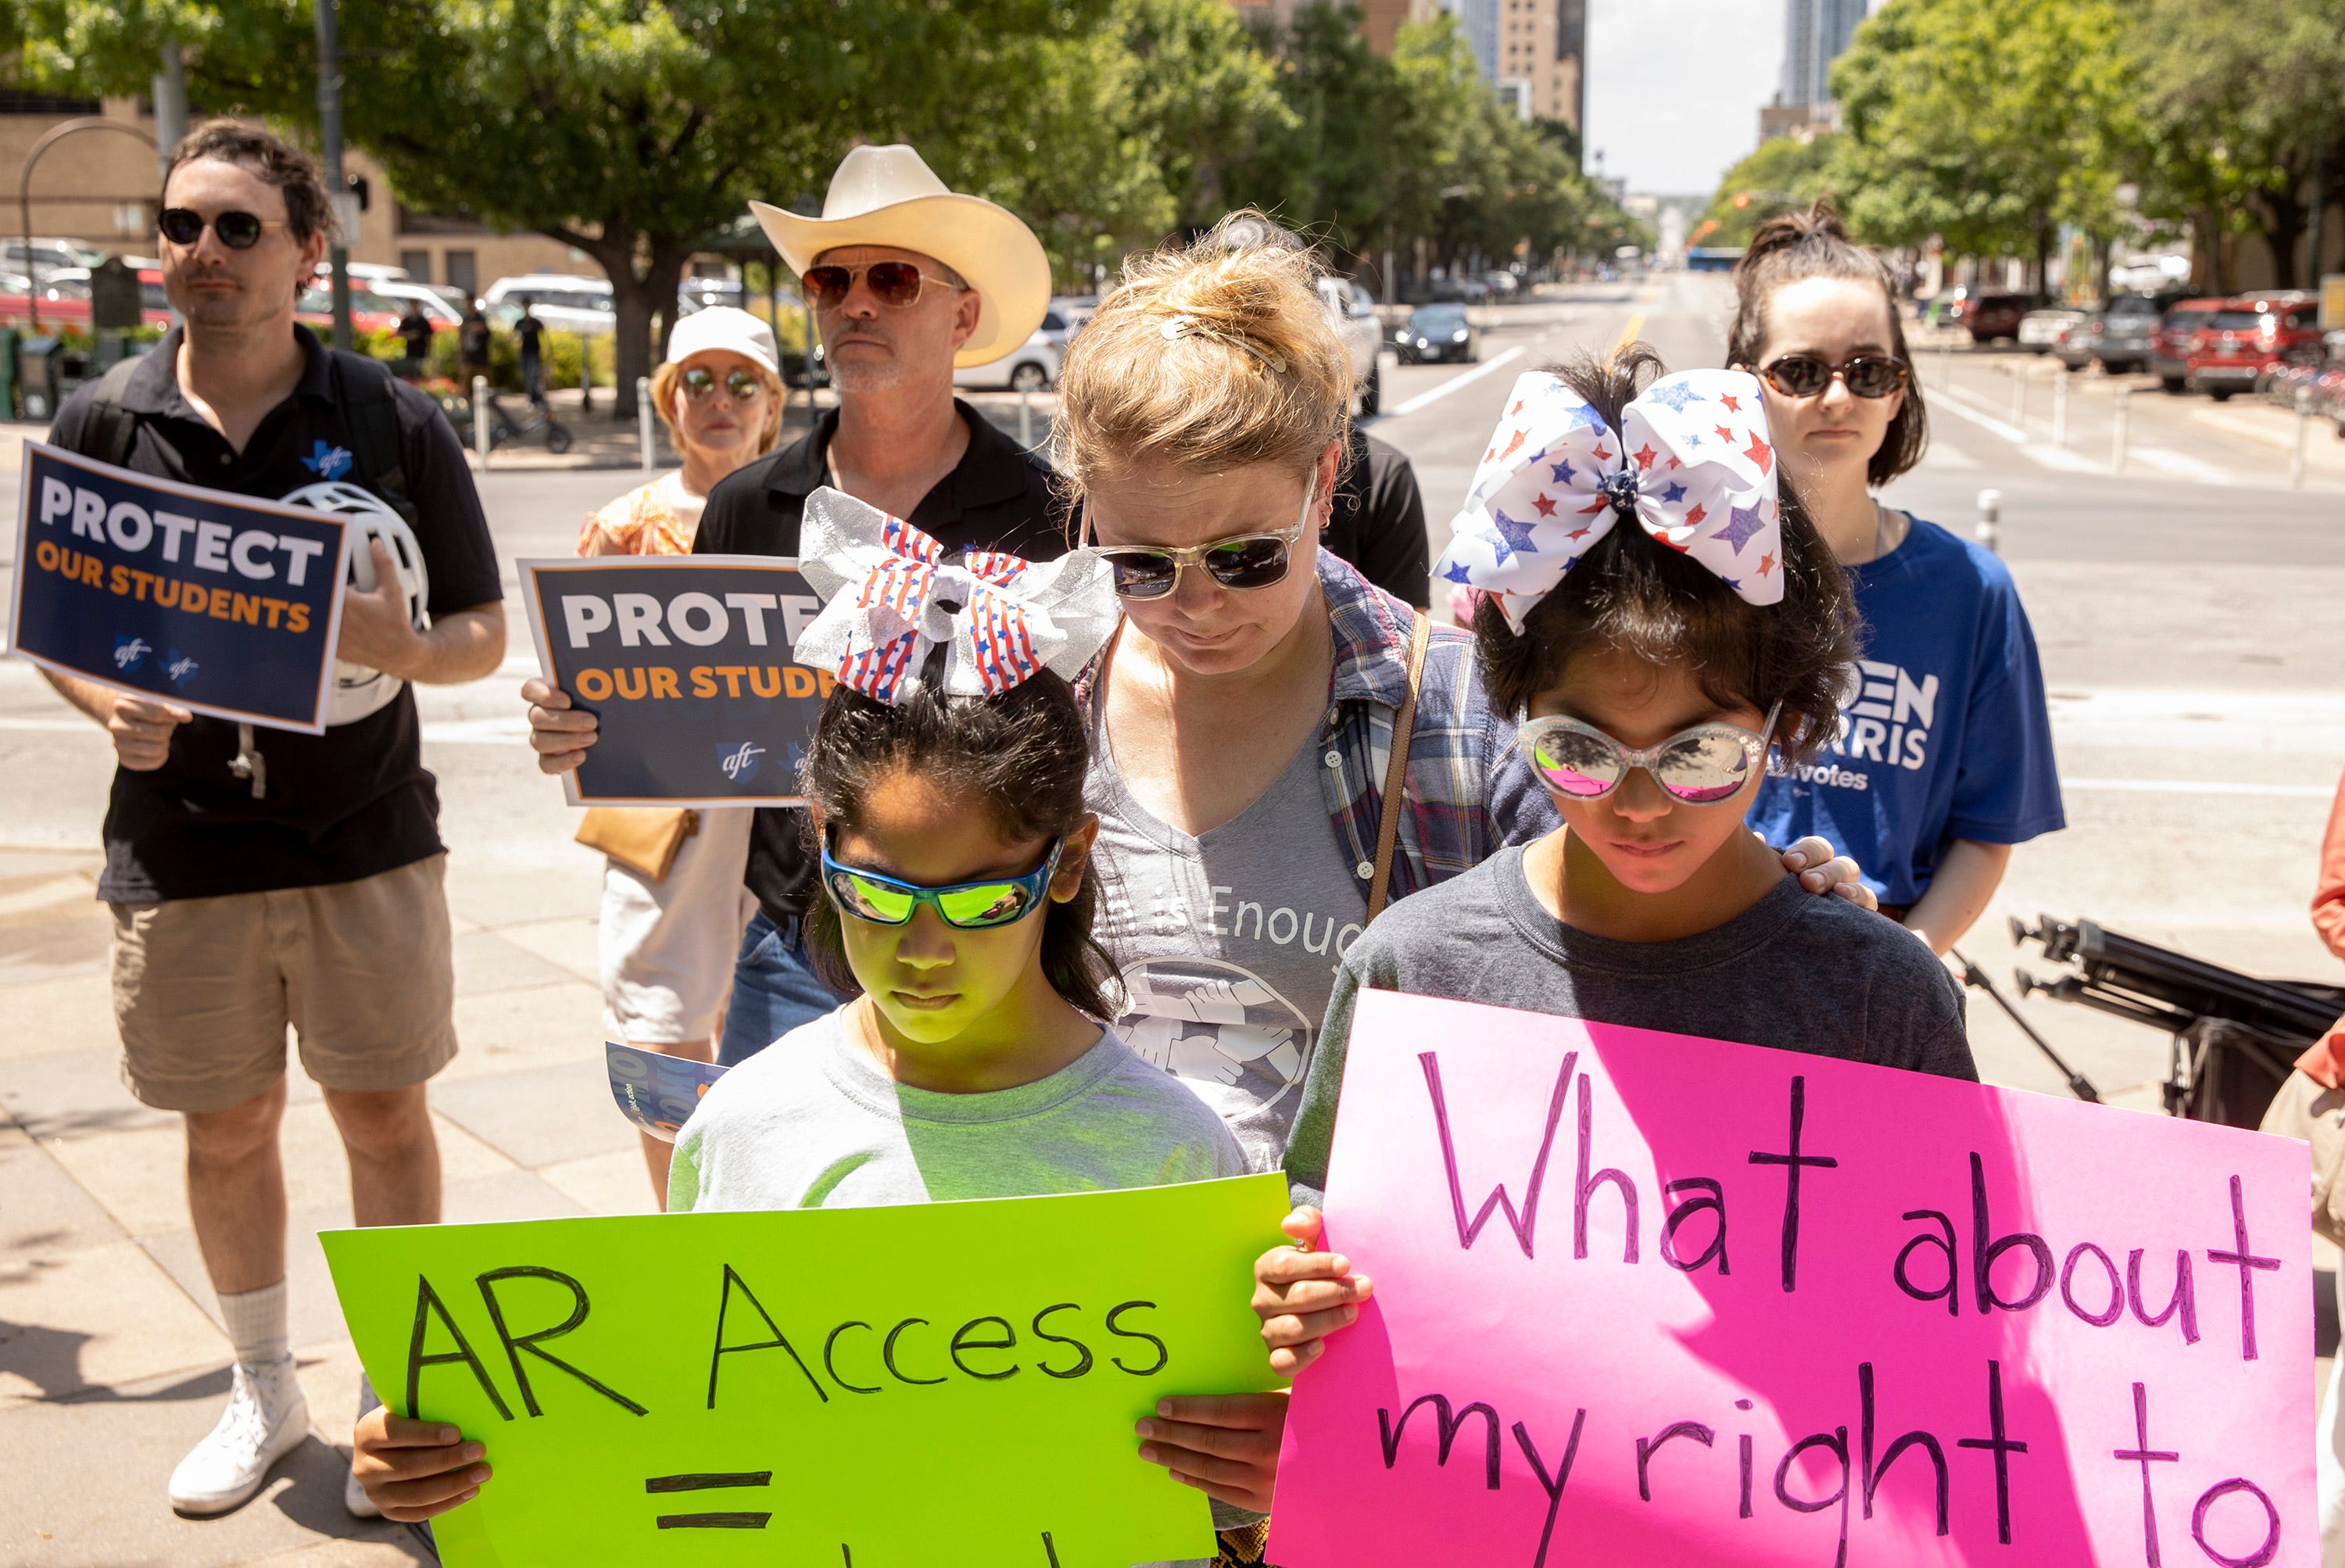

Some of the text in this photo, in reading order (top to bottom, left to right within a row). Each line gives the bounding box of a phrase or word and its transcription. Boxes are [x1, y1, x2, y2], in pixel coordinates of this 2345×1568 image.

[40, 475, 324, 586] PROTECT
[36, 540, 310, 633] OUR STUDENTS
[113, 638, 152, 668] aft
[575, 667, 683, 700] OUR
[722, 742, 766, 780] aft
[1417, 1051, 2281, 1360] What about
[406, 1263, 1168, 1421] AR Access
[646, 1471, 772, 1529] =
[1377, 1359, 2280, 1568] my right to
